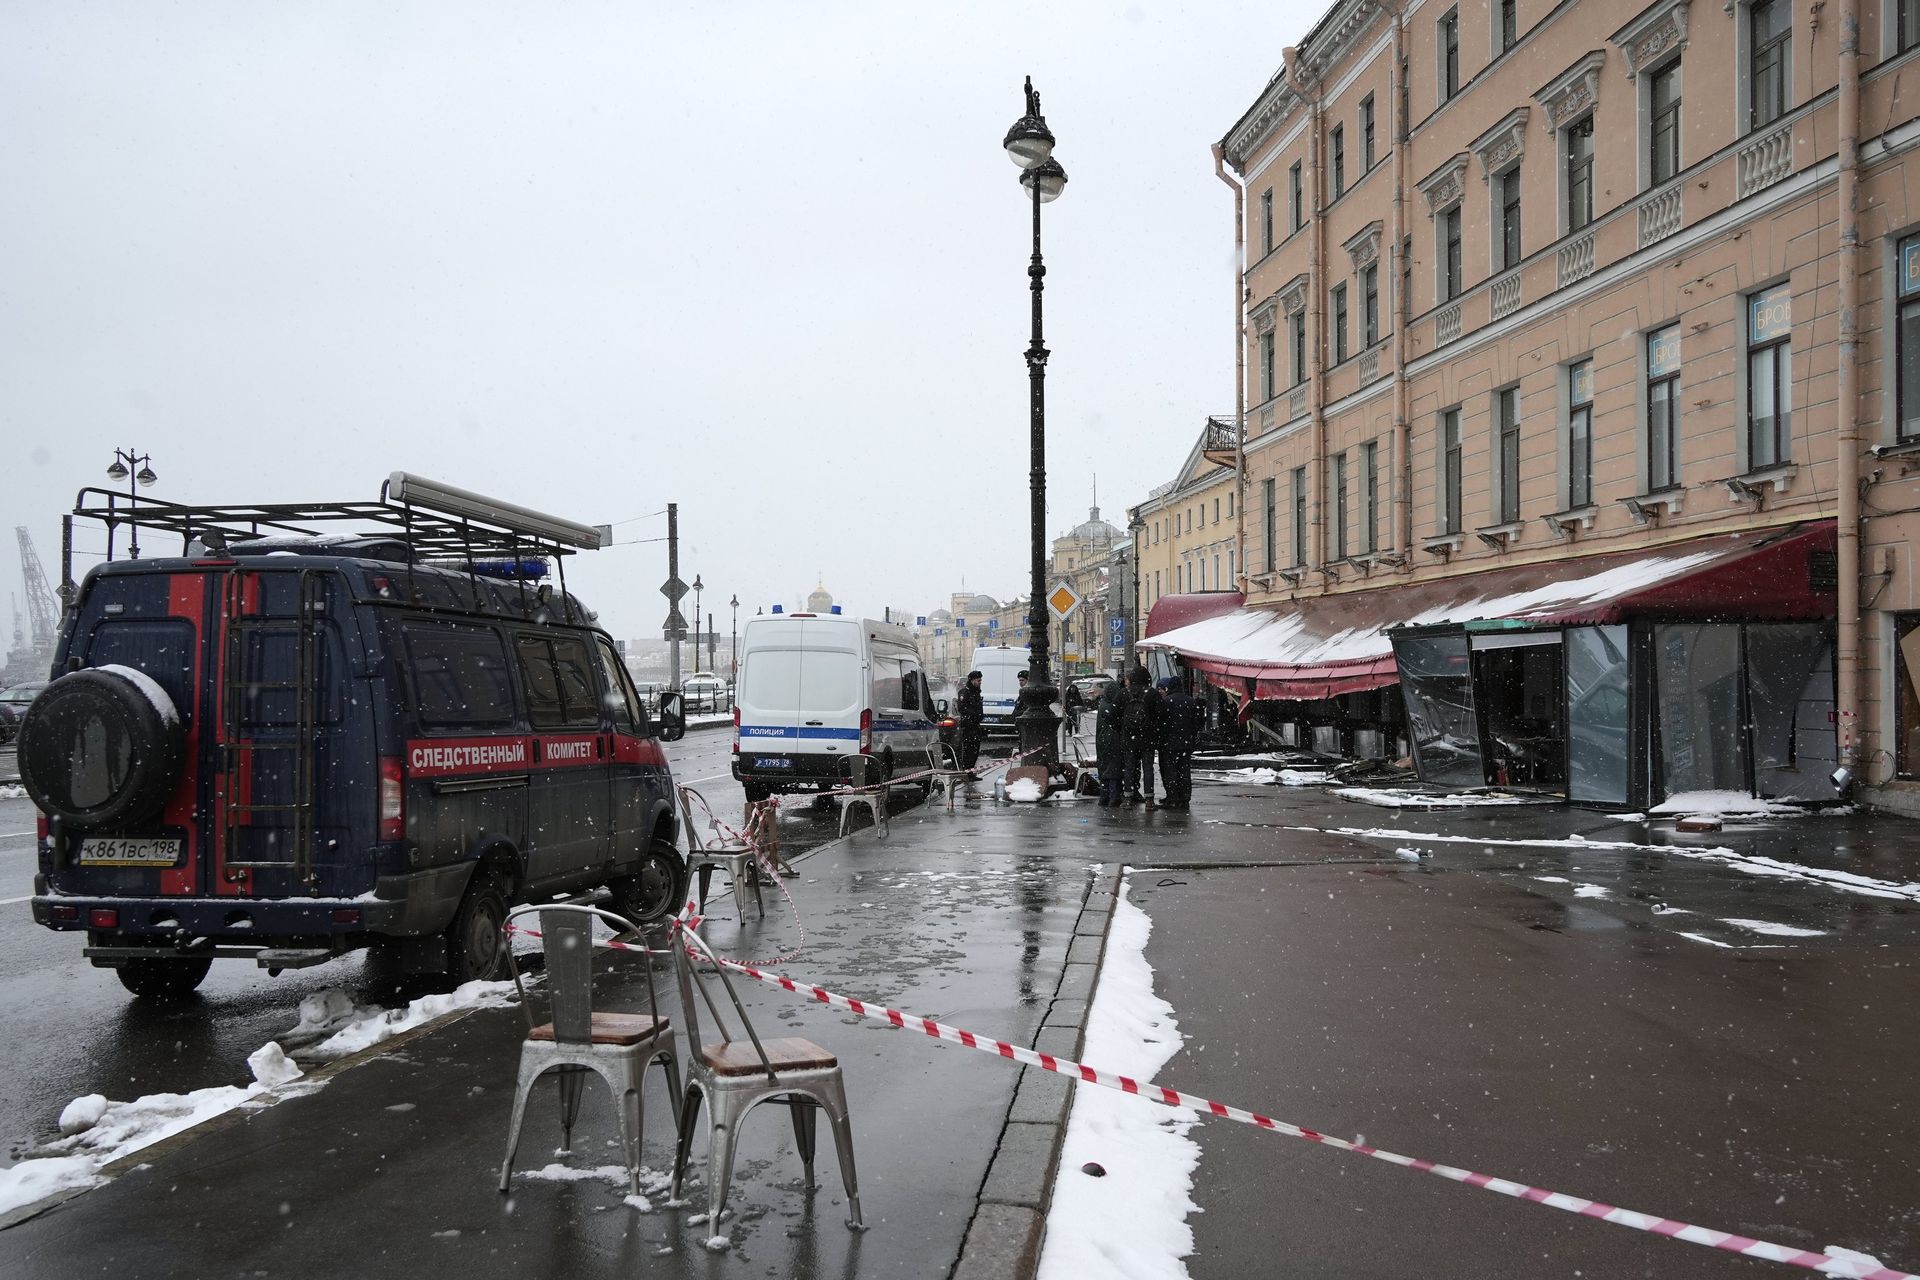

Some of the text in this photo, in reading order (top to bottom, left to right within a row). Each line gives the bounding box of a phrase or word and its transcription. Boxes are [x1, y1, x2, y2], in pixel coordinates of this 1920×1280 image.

[1114, 635, 1122, 645] P
[412, 741, 592, 769] СЛЕДСТВЕННЫЙ КОМИТЕТ
[152, 841, 175, 854] 198
